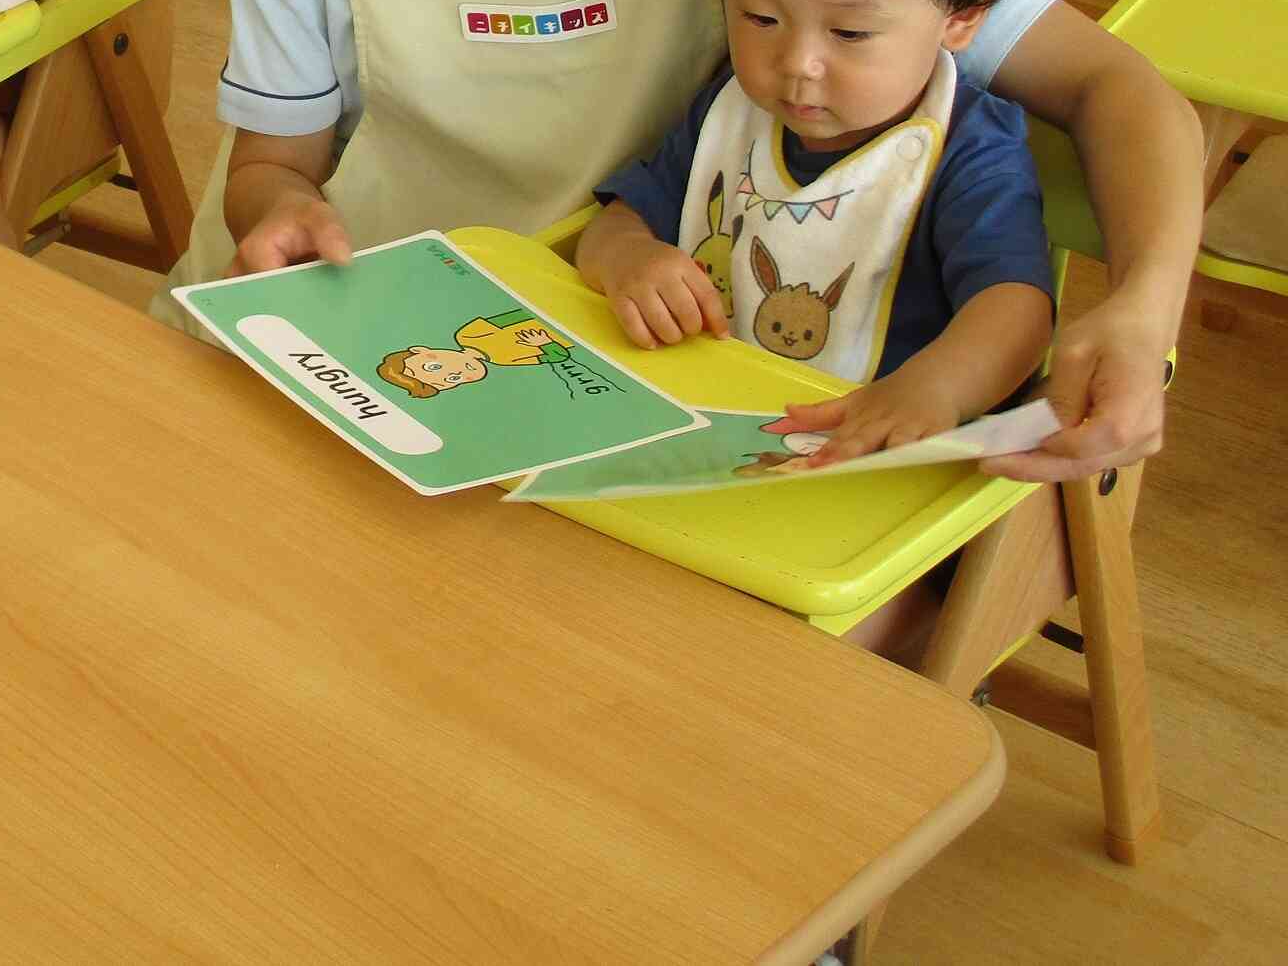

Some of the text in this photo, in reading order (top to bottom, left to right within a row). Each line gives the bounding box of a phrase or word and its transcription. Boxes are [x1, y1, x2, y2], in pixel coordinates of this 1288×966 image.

[474, 8, 607, 35] ニチイキッズ
[287, 353, 389, 420] hungry
[560, 363, 610, 395] grrr
